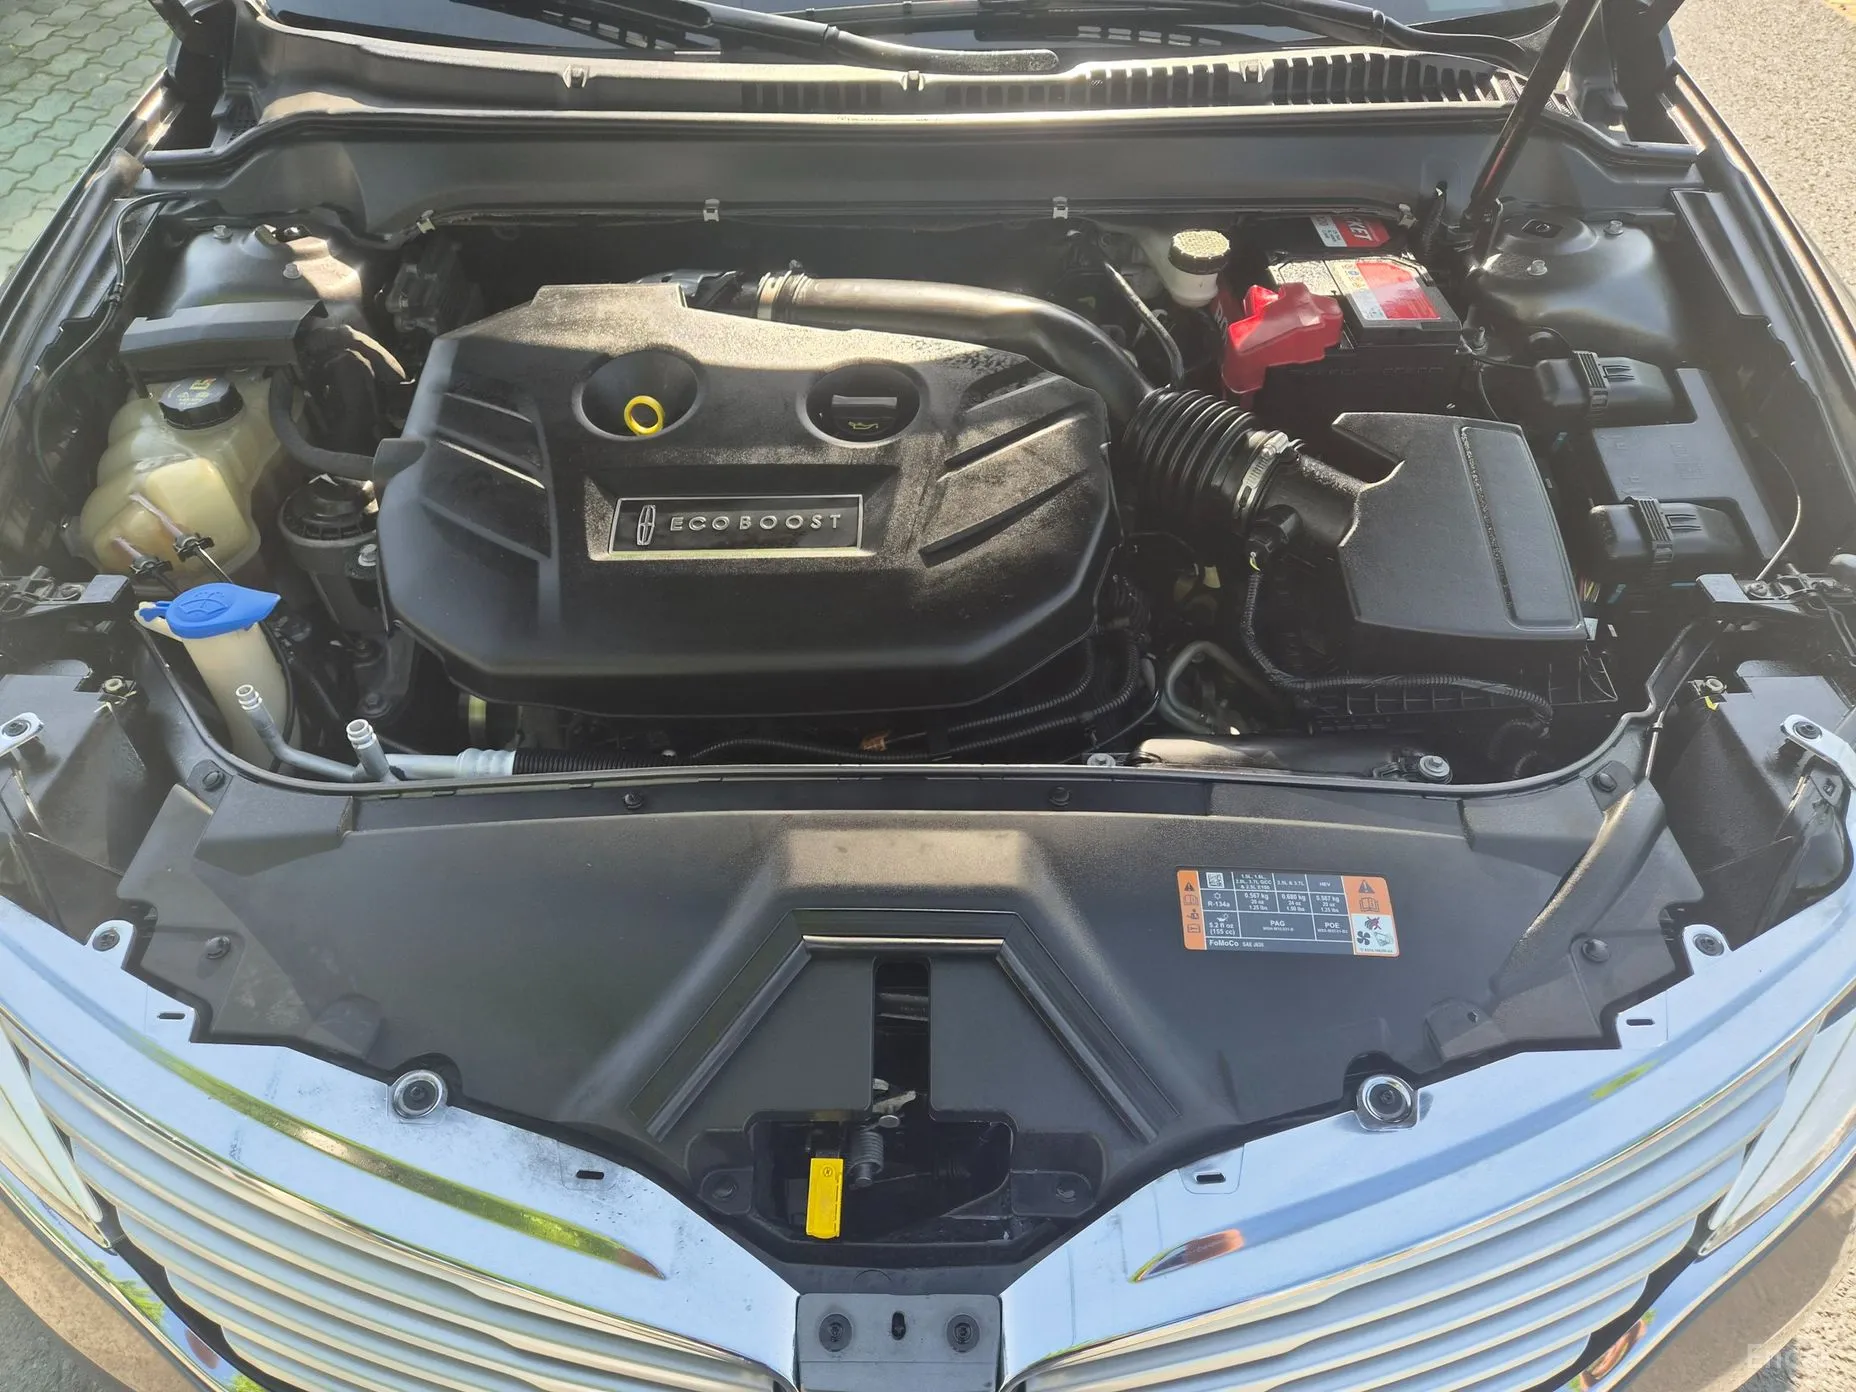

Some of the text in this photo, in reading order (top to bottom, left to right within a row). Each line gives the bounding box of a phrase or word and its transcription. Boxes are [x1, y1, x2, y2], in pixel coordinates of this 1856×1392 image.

[669, 514, 842, 531] ECOBOOST
[1298, 894, 1306, 902] kg
[1209, 939, 1240, 947] FoMoCo
